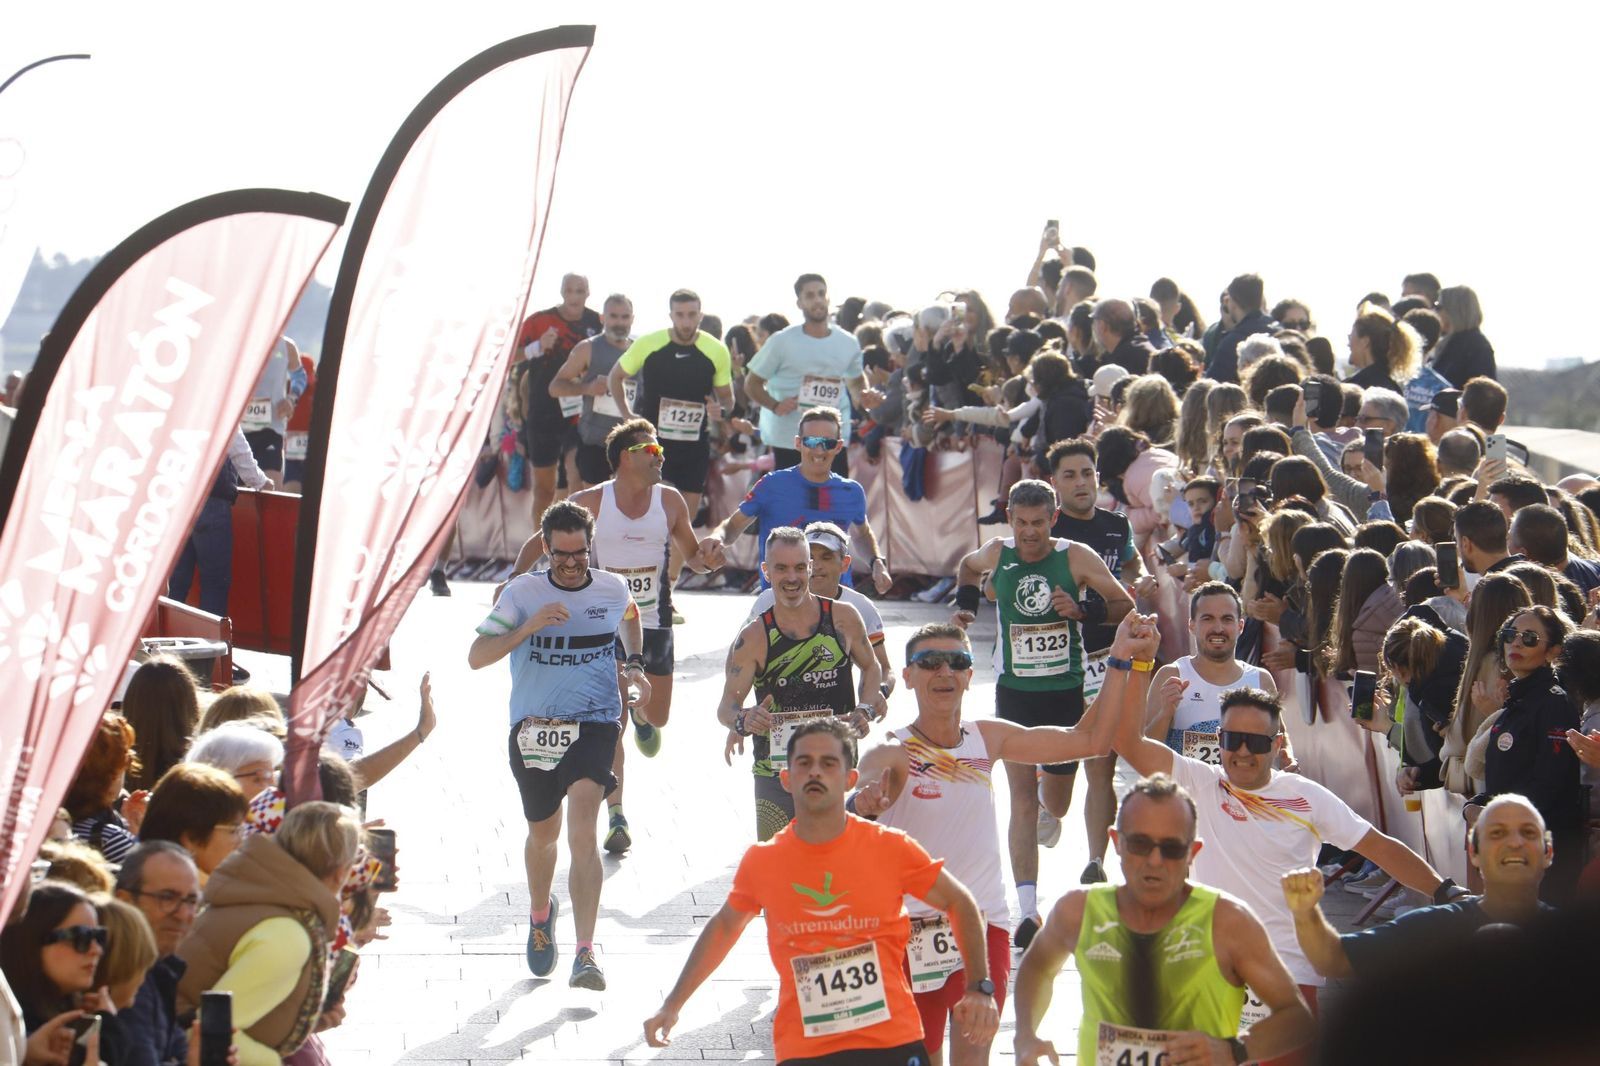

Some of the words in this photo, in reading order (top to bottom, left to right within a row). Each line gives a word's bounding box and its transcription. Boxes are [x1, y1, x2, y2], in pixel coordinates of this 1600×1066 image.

[813, 385, 839, 398] 1099
[671, 410, 702, 423] 1212
[58, 276, 216, 595] MARATÓN
[105, 428, 210, 612] CÓRDOBA
[1025, 634, 1068, 652] 1323
[815, 681, 838, 689] TRAIL
[536, 730, 571, 747] 805
[778, 915, 880, 936] Extremadura
[809, 955, 832, 965] MEDIA
[814, 961, 878, 996] 1438
[1117, 1031, 1143, 1040] MEDIA
[1147, 1031, 1171, 1042] MAR
